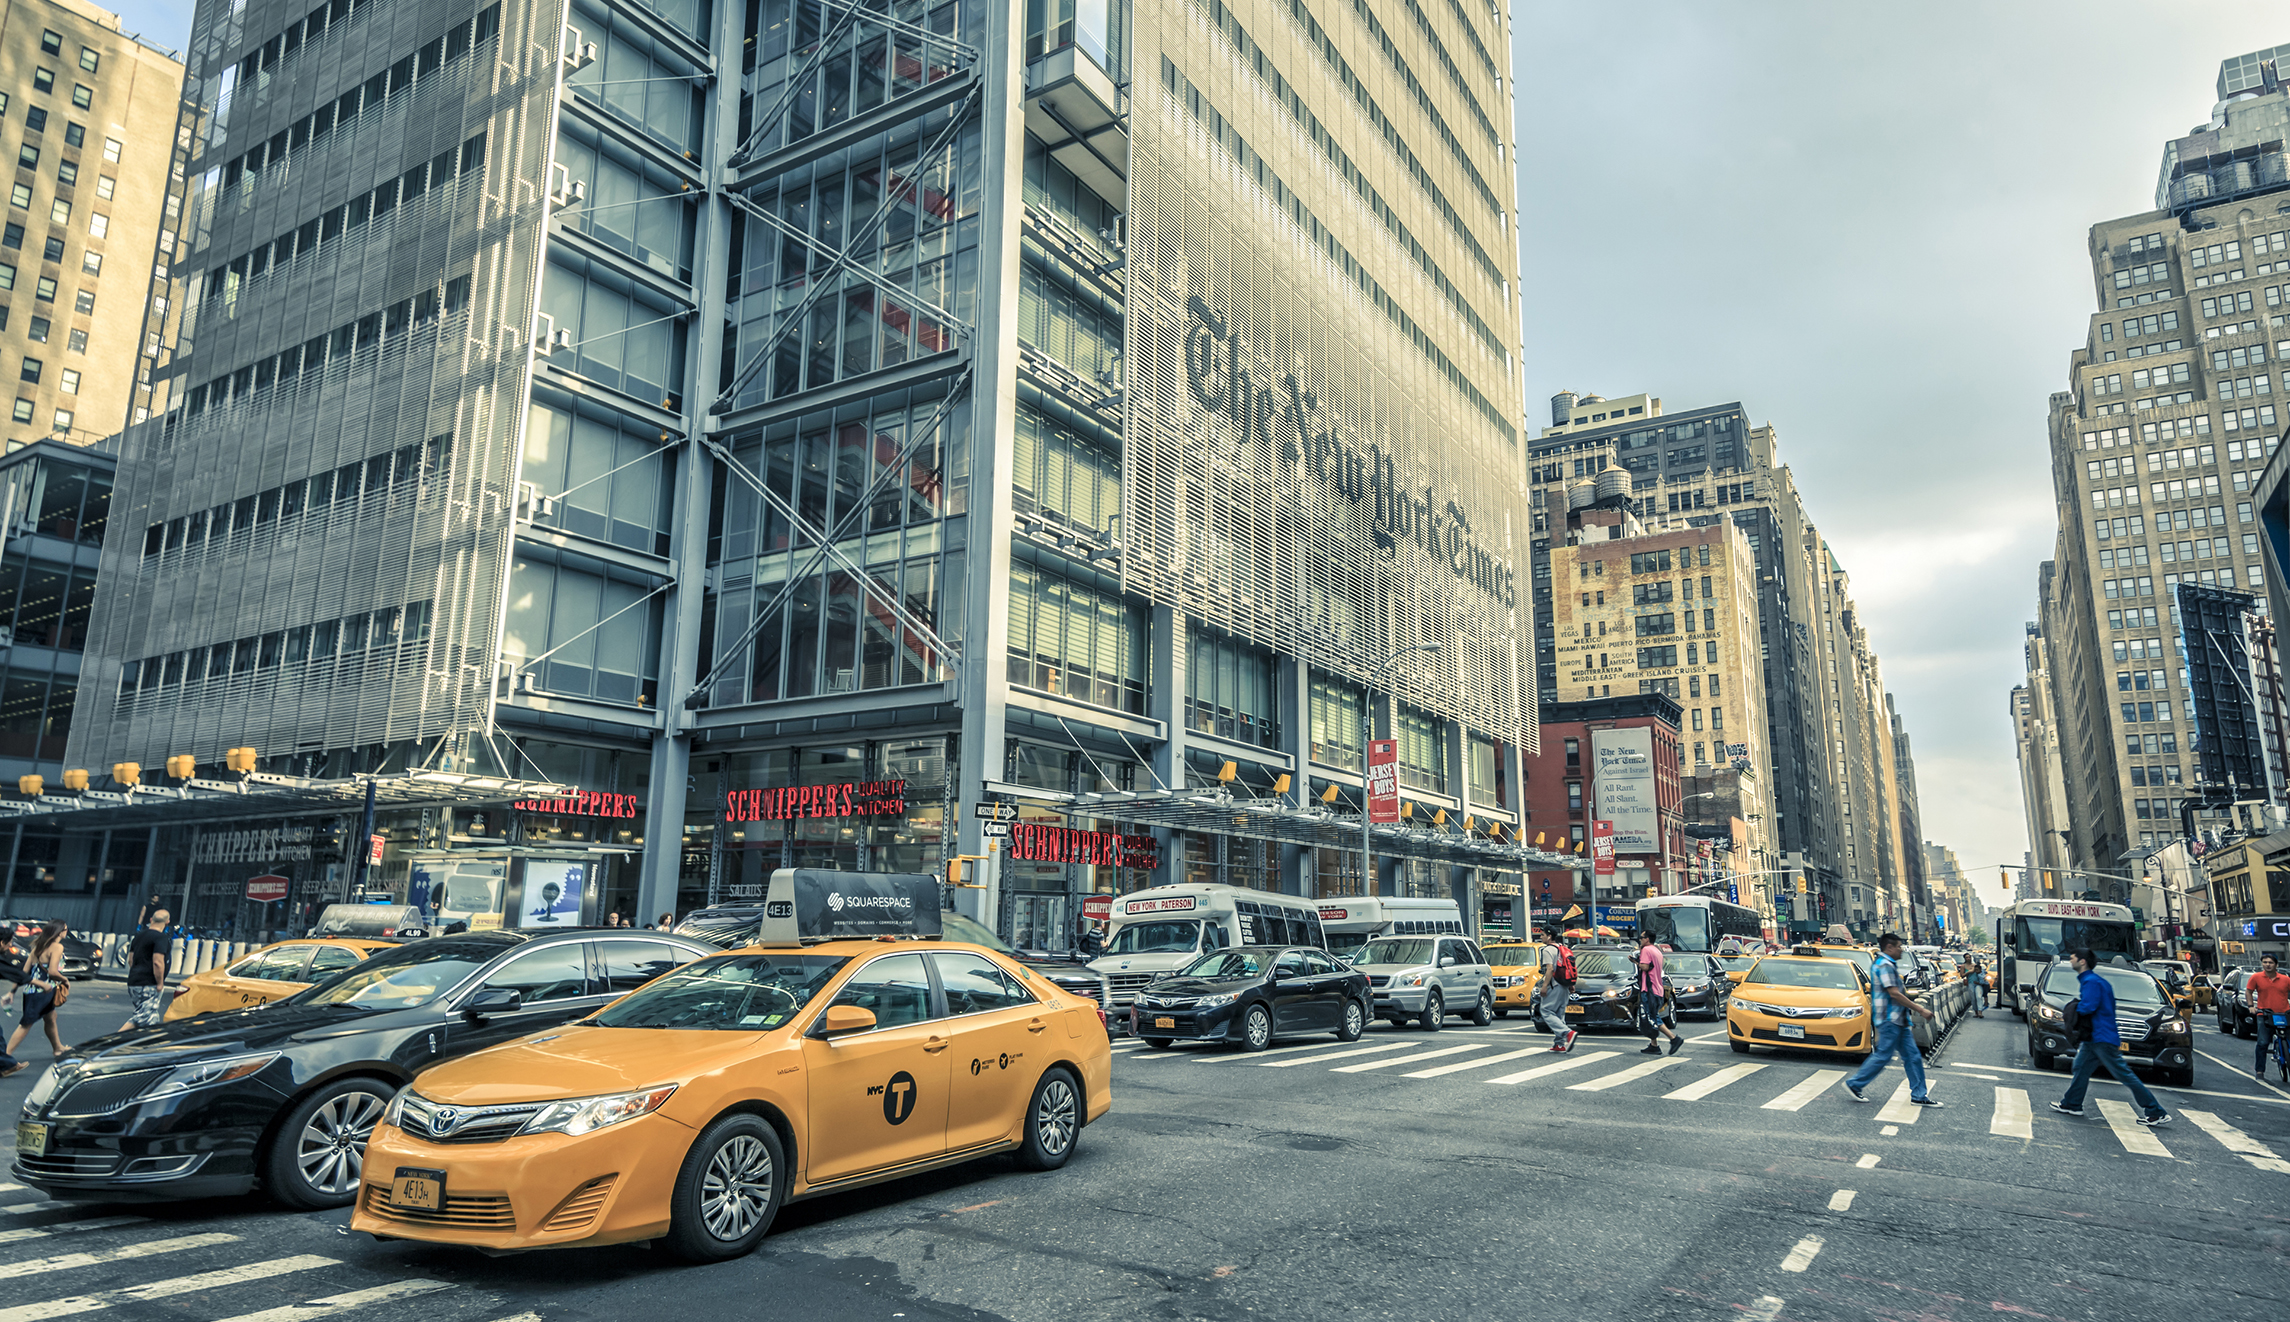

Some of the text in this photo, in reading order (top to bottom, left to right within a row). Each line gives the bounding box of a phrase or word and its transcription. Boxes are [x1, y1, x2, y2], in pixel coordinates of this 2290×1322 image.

[1185, 295, 1515, 610] The New York Times
[1624, 604, 1670, 617] SEA
[1677, 598, 1719, 611] AIR
[1574, 637, 1601, 645] MEXICO
[1581, 643, 1605, 651] HAWAII
[1608, 640, 1633, 648] PUERTO
[1635, 638, 1651, 646] RICO
[1653, 635, 1684, 644] BERMUDA
[1688, 632, 1721, 641] BAHAMAS
[1609, 658, 1635, 666] AMERICA
[1571, 666, 1623, 676] MEDITERRANEAN
[1622, 671, 1644, 679] GREEK
[1646, 669, 1671, 677] ISLAND
[1674, 666, 1707, 675] CRUISES
[1600, 747, 1636, 757] The New
[1601, 757, 1646, 766] York Times
[1369, 761, 1397, 781] JERSEY
[1603, 766, 1649, 776] Against Israel
[1373, 778, 1395, 796] BOYS
[1604, 784, 1636, 792] All Rant.
[725, 779, 906, 822] SCHNIPPER'S QUALITY
[1616, 795, 1638, 803] Slant.
[857, 800, 905, 816] KITCHEN
[980, 807, 1013, 817] ONE WAY
[282, 826, 315, 843] QUALITY
[191, 828, 312, 865] SCHNIPPER'S KITCHEN
[1011, 822, 1157, 867] SCHNIPPER'S QUALITY
[1593, 835, 1614, 848] JERSEY
[1597, 846, 1612, 857] BOYS
[1124, 853, 1157, 869] KITCHEN
[729, 884, 763, 897] SALADS
[847, 896, 911, 908] SQUARESPACE
[1128, 902, 1140, 912] NEW
[1141, 901, 1157, 910] YORK
[1161, 898, 1192, 909] PATERSON
[768, 905, 793, 916] 4E13
[2047, 903, 2060, 914] BLVD.
[2061, 904, 2072, 915] EAST
[2074, 905, 2086, 917] NEW
[2087, 906, 2101, 918] YORK
[405, 929, 421, 937] 4L99
[867, 1081, 911, 1119] NYC T
[403, 1180, 429, 1200] 4E13H
